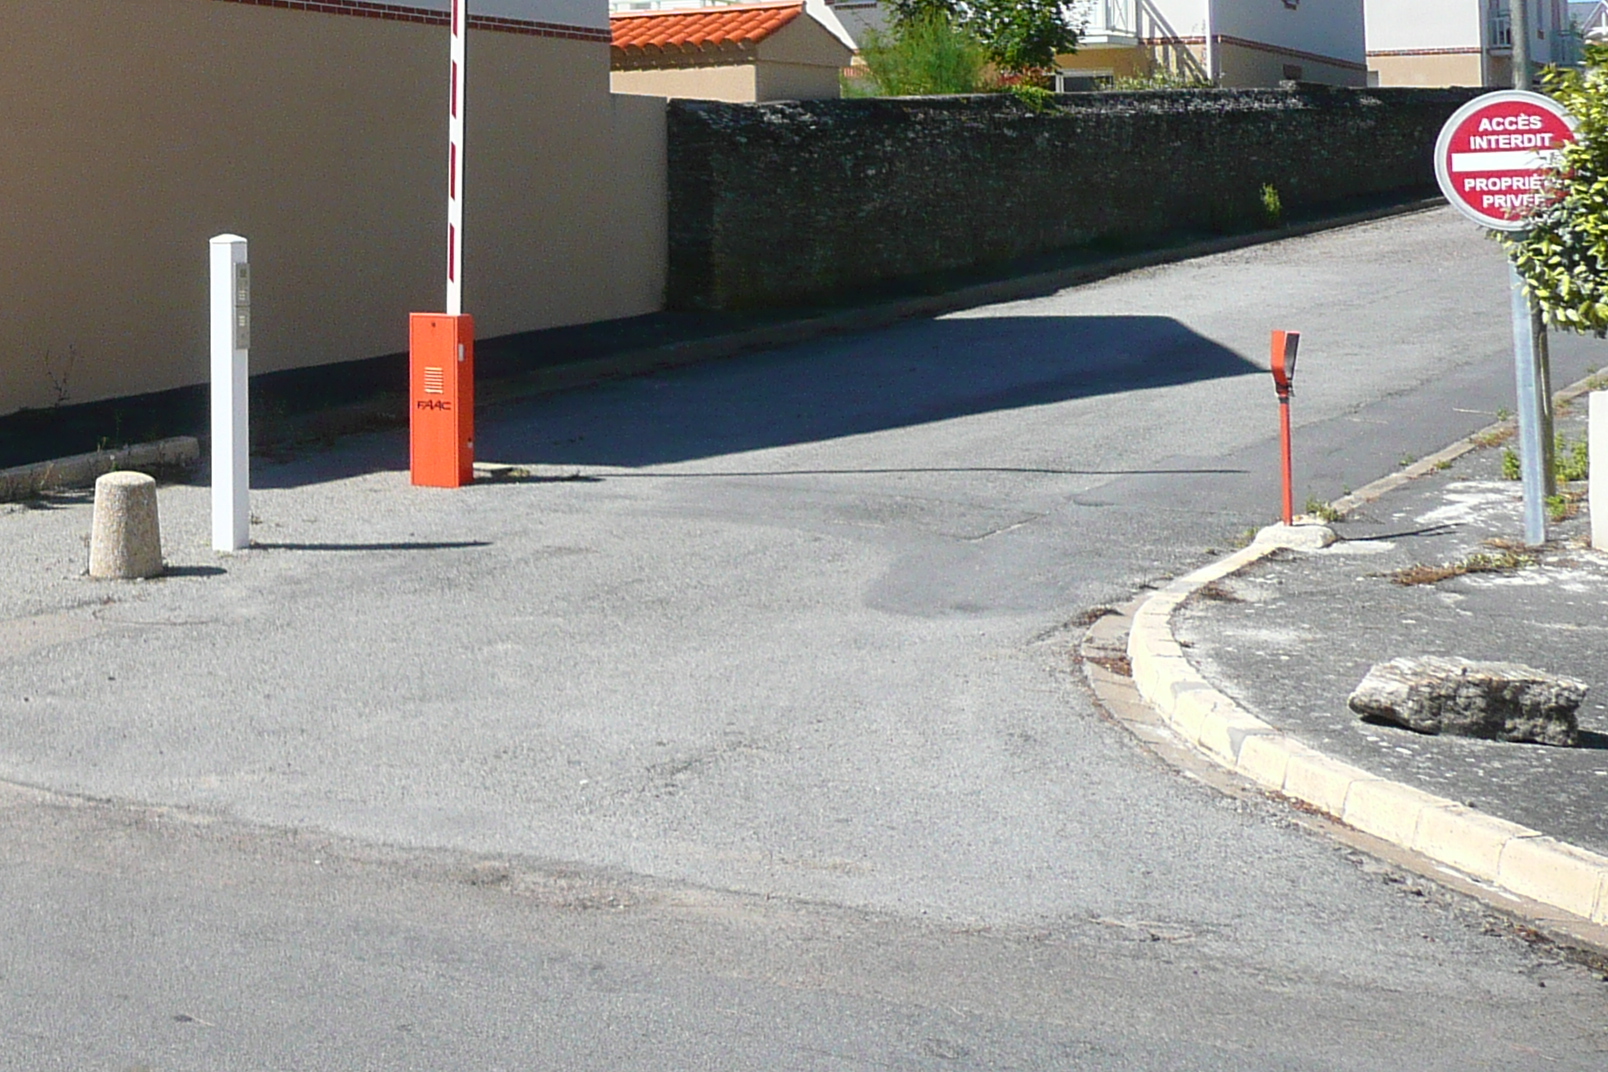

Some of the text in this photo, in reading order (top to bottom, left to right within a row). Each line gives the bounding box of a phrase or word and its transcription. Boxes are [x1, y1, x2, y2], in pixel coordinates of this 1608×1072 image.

[1478, 113, 1543, 132] ACCÈS
[1469, 133, 1554, 150] INTERDIT
[416, 399, 452, 411] FAAC
